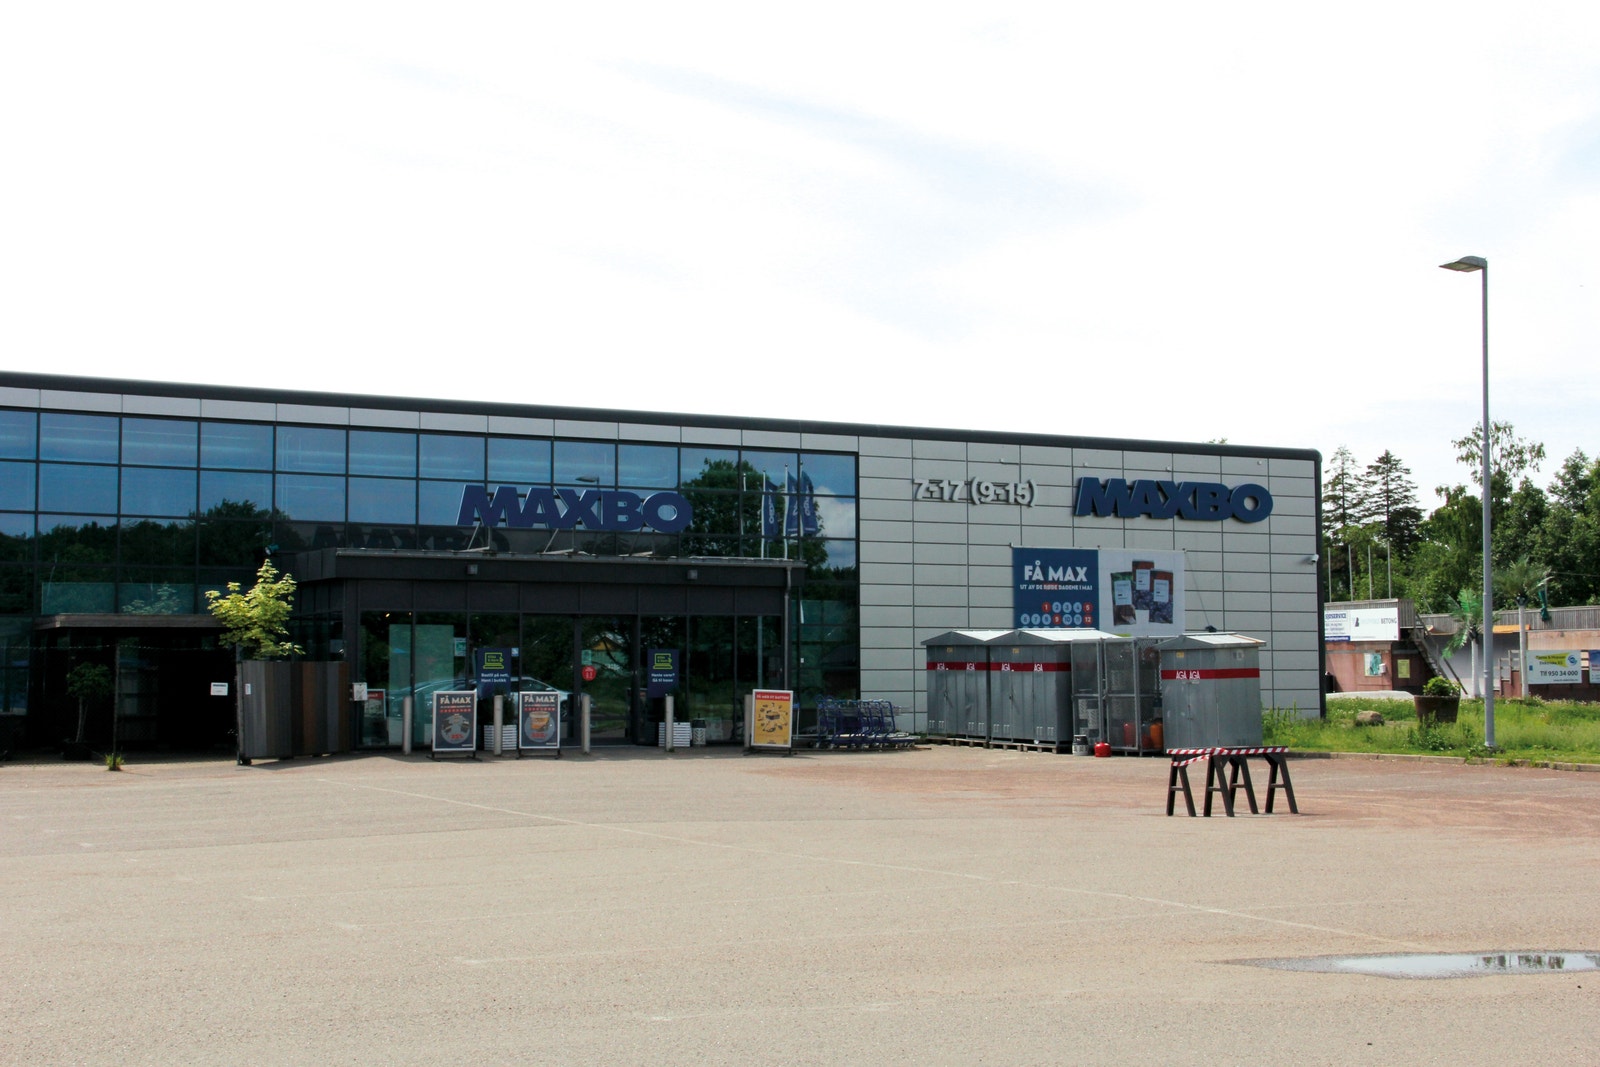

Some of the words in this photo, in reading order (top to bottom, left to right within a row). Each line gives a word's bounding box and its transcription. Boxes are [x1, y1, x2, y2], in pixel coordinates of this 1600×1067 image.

[913, 478, 965, 501] 7-17
[971, 477, 1037, 507] (9-15)
[1074, 476, 1274, 523] MAXBO
[456, 484, 693, 533] MAXBO
[1024, 560, 1044, 581] FÅ
[1048, 566, 1088, 582] MAX
[966, 663, 975, 671] AGA
[1176, 670, 1187, 680] AGA
[1189, 670, 1200, 680] AGA
[440, 695, 450, 704] FÅ
[524, 694, 534, 702] FÅ
